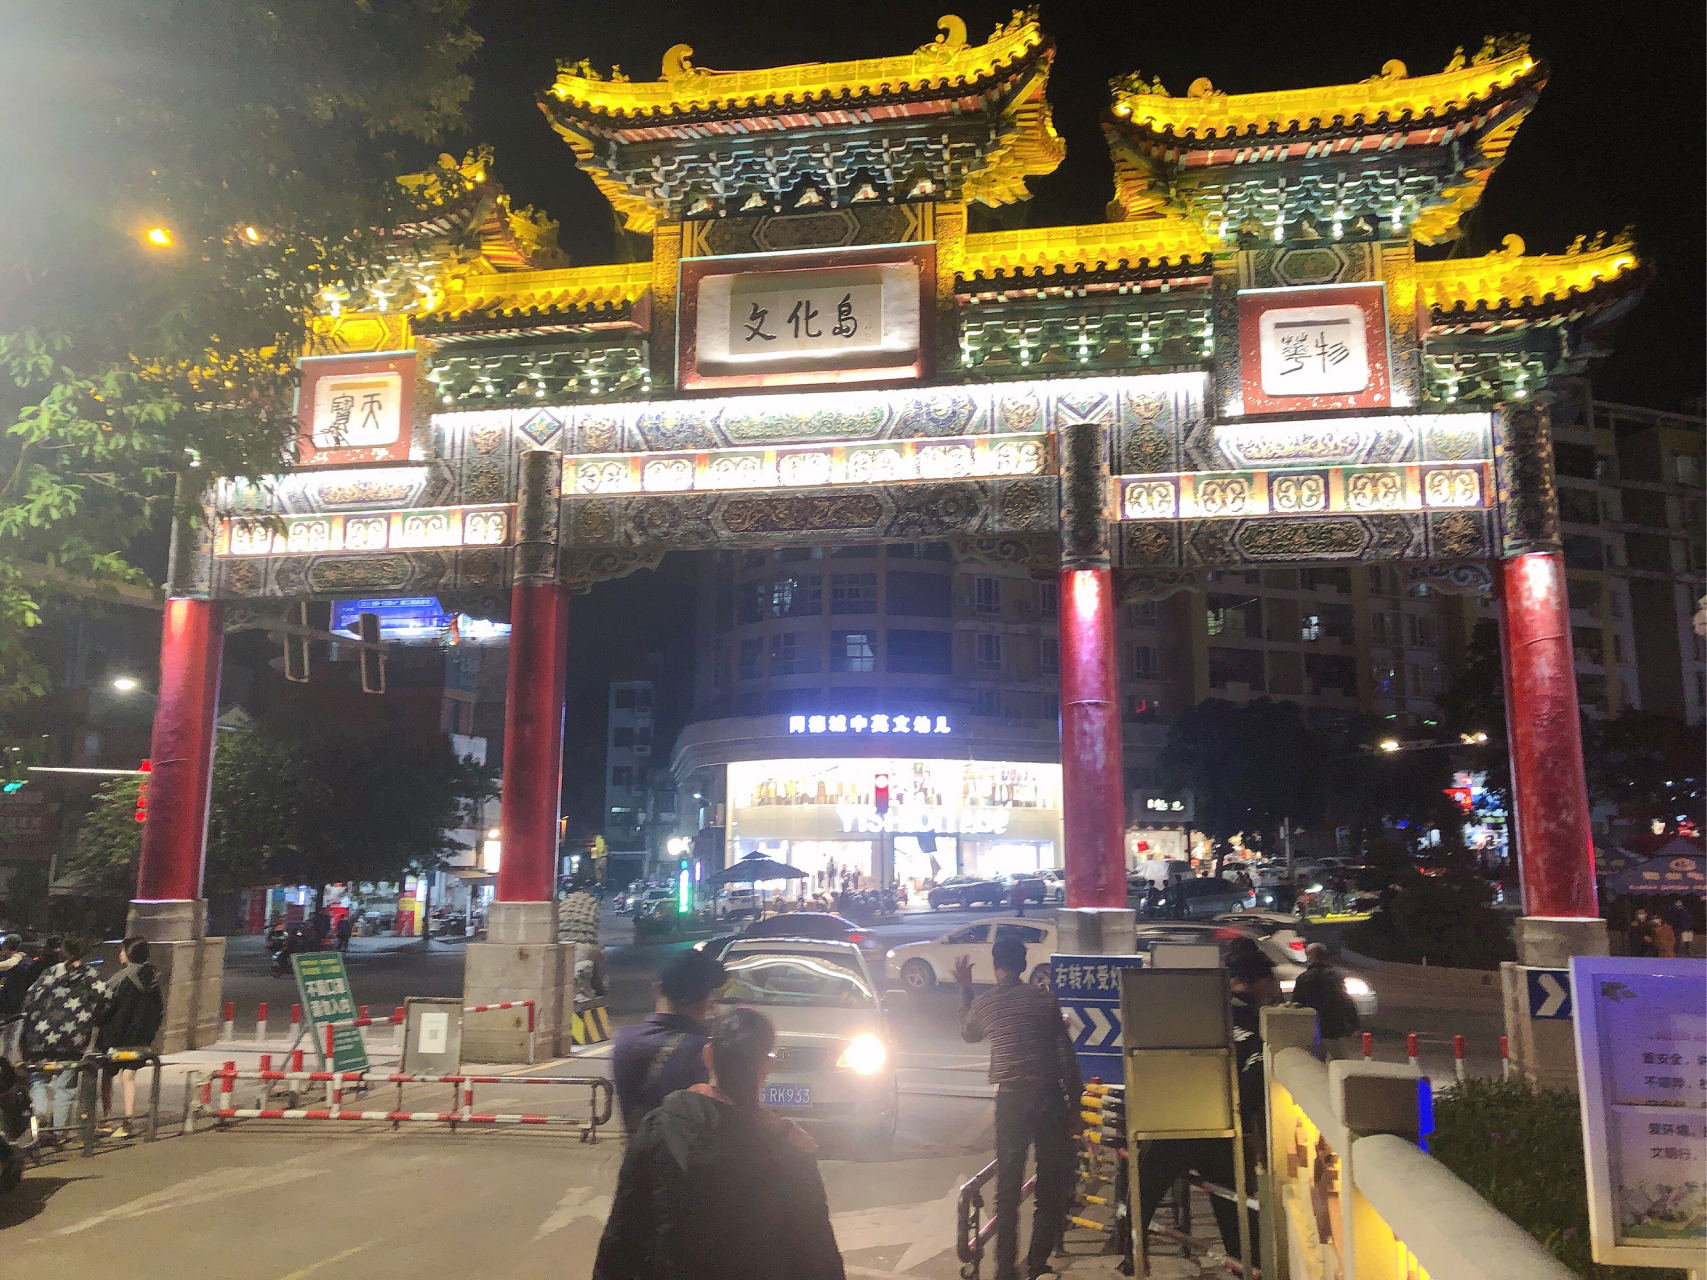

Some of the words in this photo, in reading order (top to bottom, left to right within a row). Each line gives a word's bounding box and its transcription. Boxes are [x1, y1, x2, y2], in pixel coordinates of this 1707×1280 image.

[1055, 963, 1134, 991] 右转不受灯
